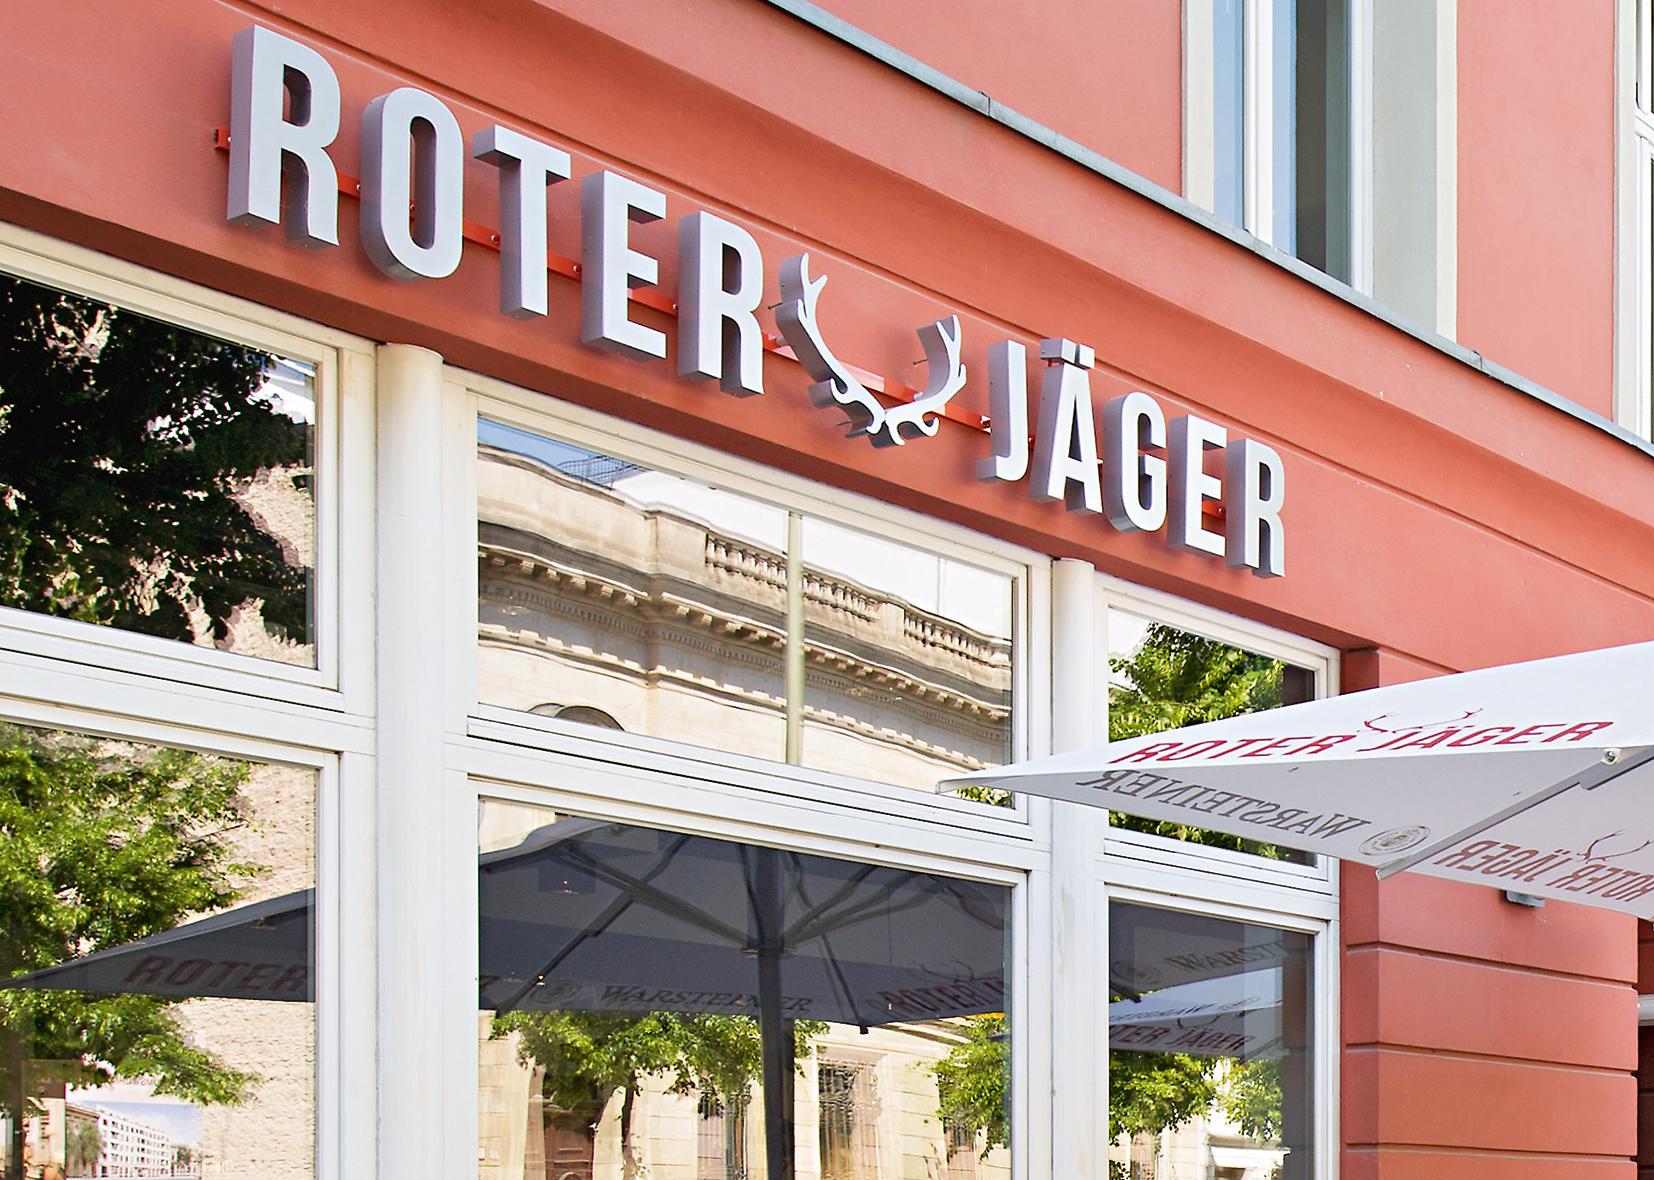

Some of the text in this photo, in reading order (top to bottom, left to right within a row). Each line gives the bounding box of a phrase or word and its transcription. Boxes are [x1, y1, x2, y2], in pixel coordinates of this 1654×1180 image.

[226, 25, 1286, 578] ROTER JÄGER
[1107, 721, 1614, 764] ROTER JÄGER
